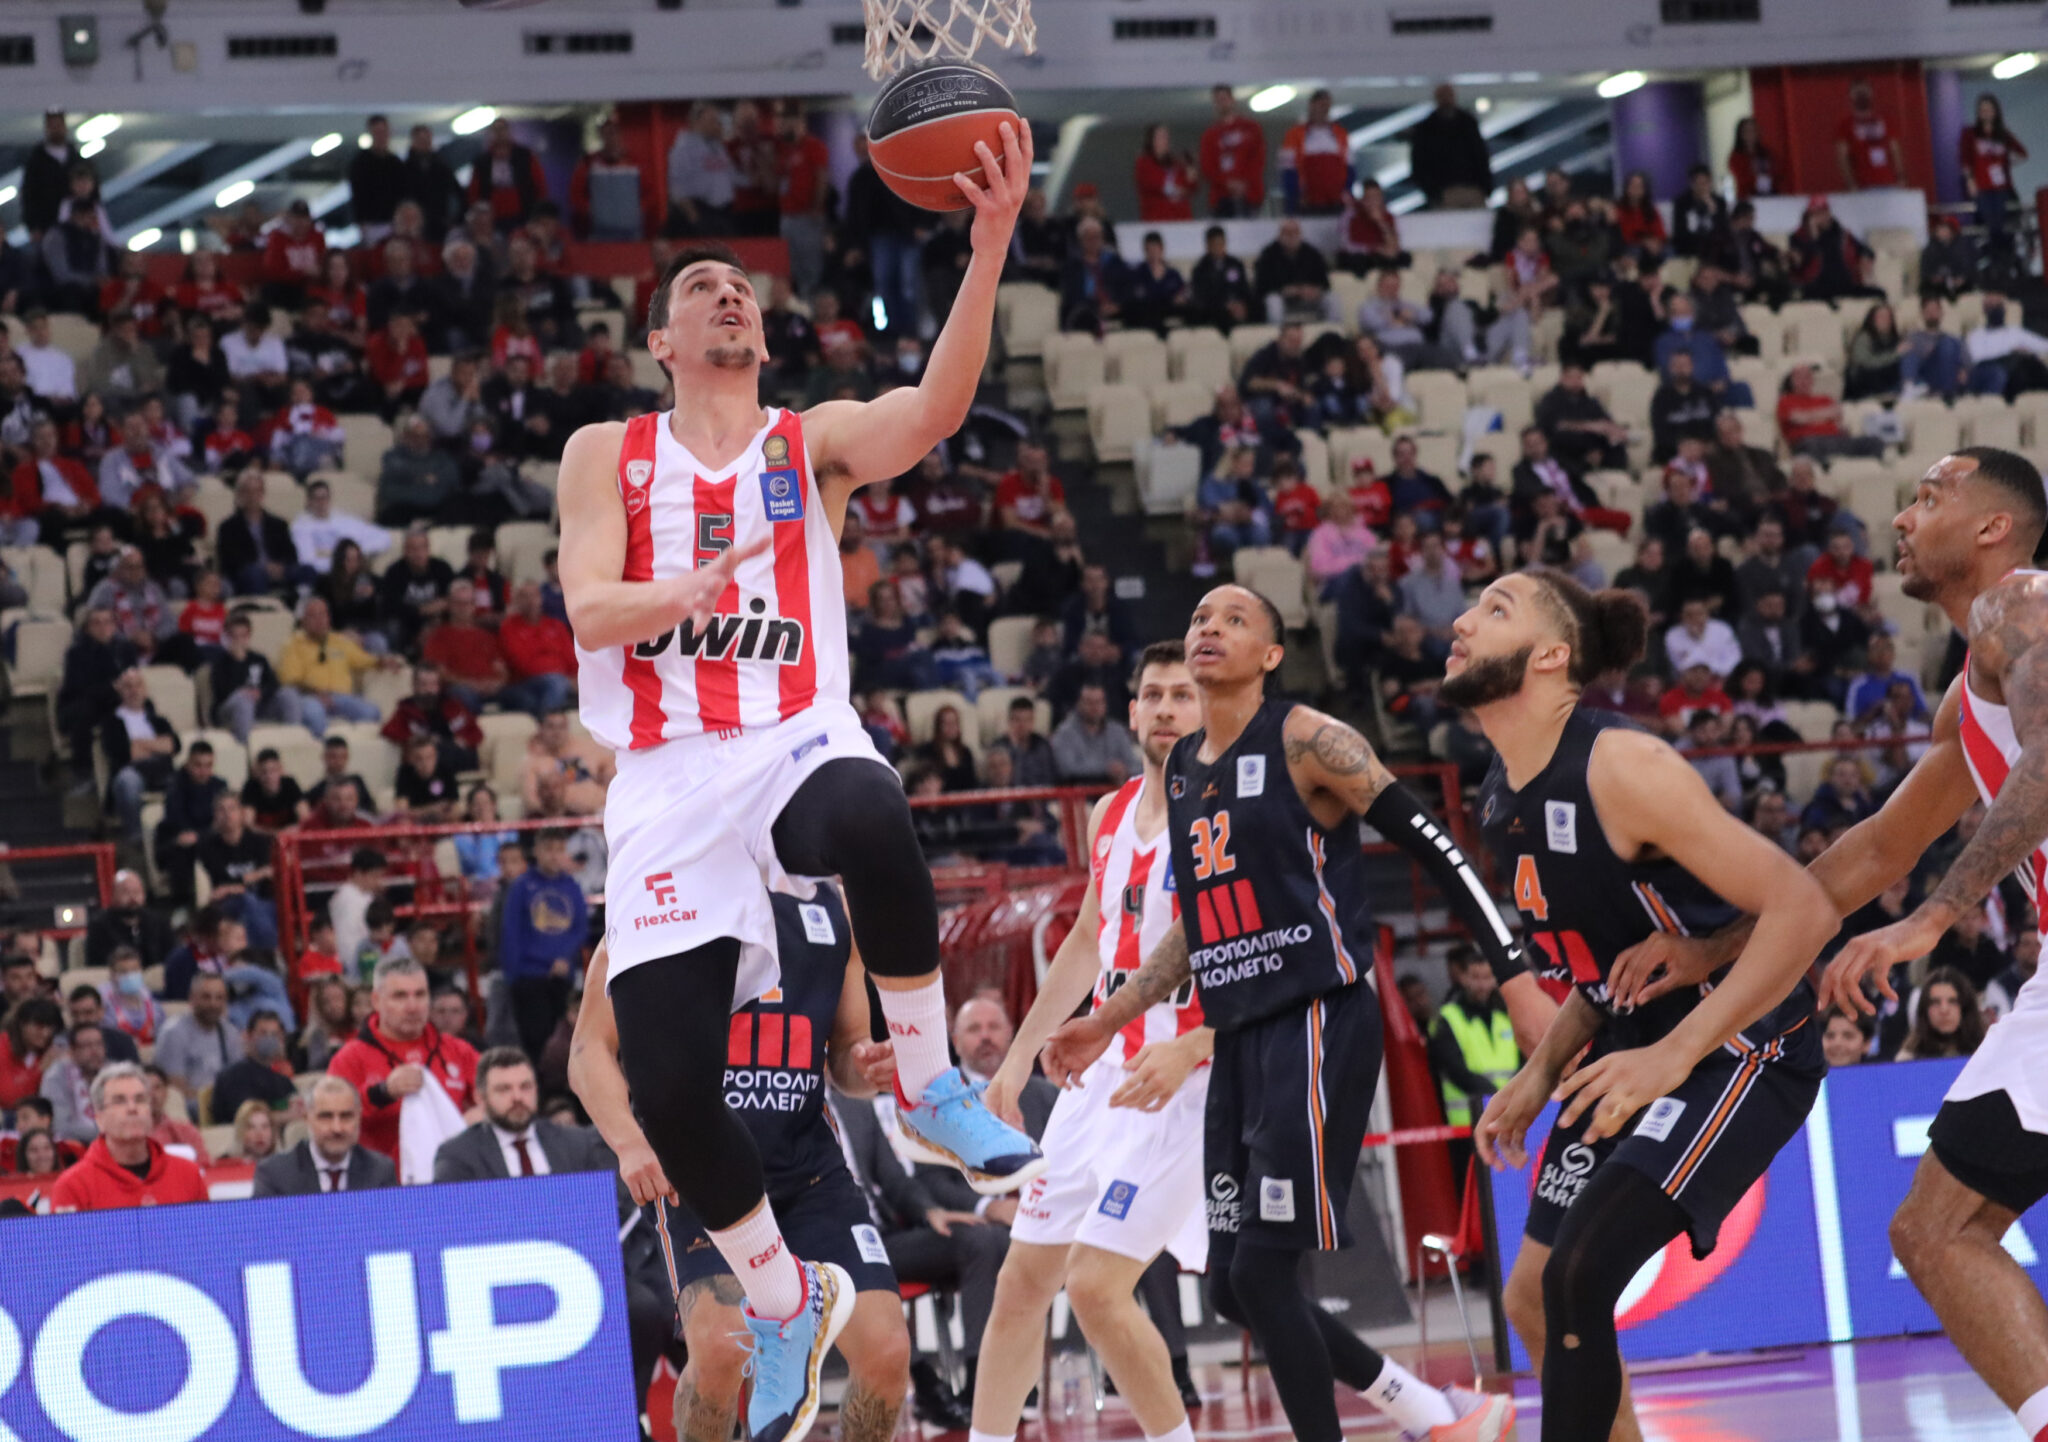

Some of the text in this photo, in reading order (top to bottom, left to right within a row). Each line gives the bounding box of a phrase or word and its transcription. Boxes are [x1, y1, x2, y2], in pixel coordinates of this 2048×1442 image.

[769, 499, 795, 509] Basket
[770, 506, 796, 516] League
[698, 513, 732, 568] 5
[1189, 810, 1236, 881] 32
[1514, 854, 1548, 921] 4
[634, 909, 698, 931] FlexCar
